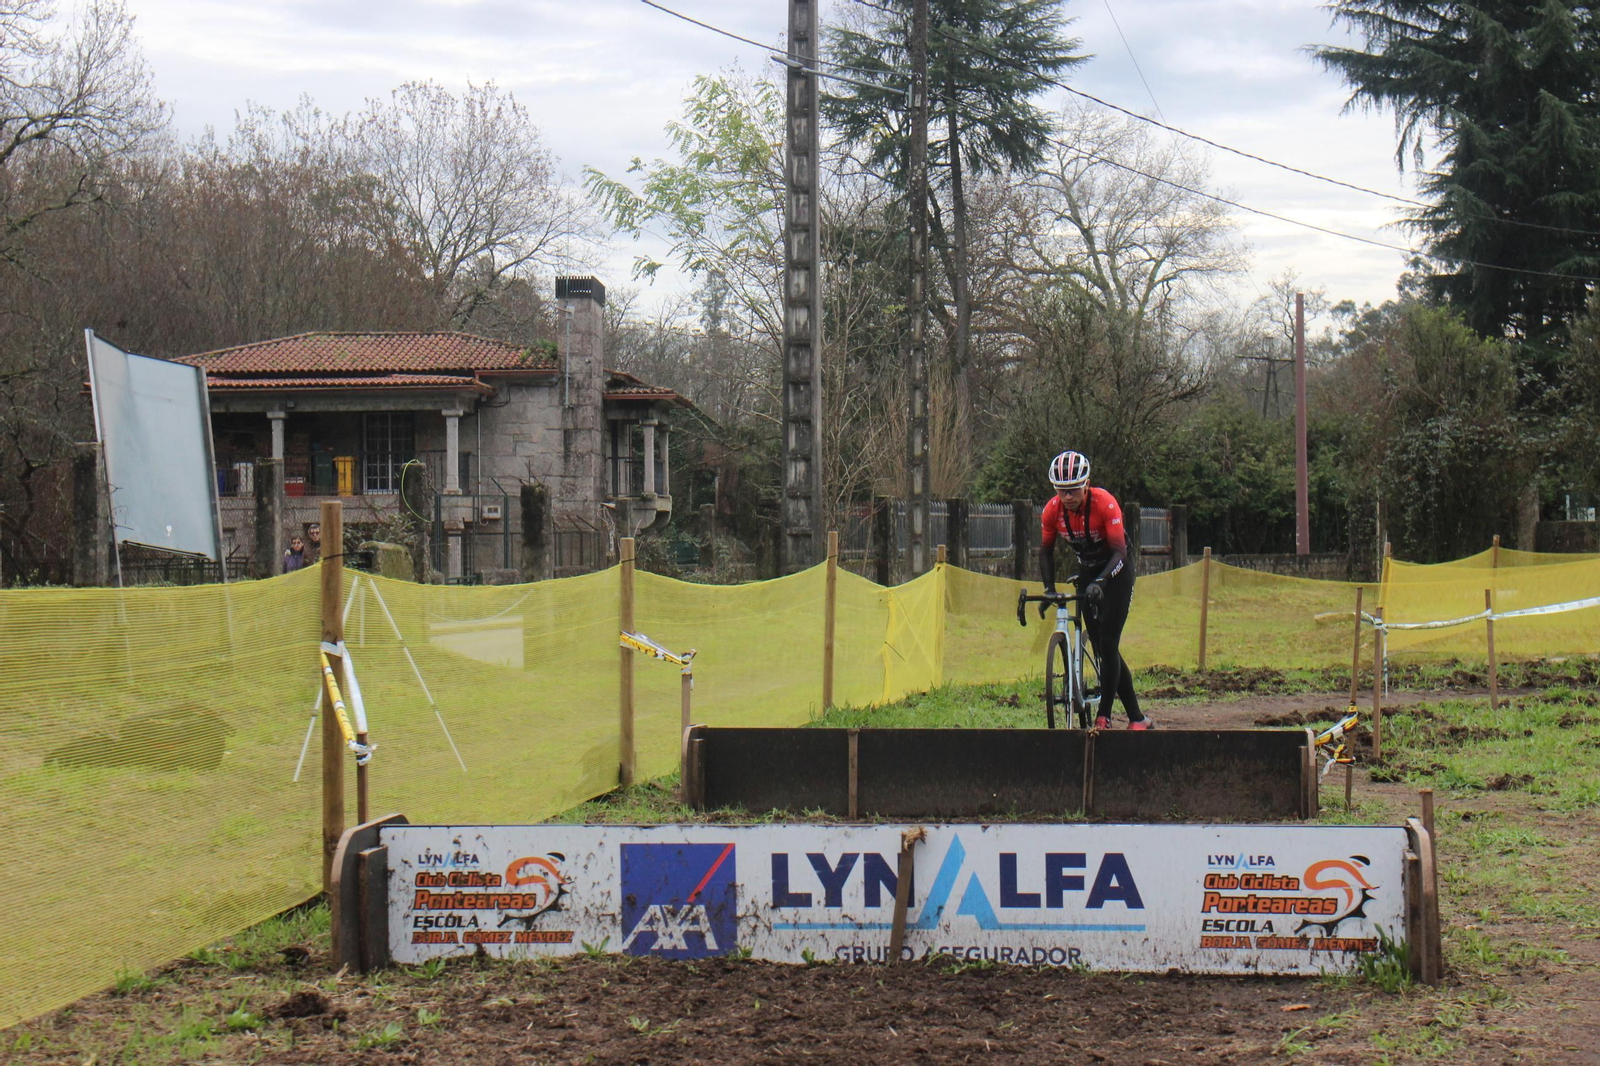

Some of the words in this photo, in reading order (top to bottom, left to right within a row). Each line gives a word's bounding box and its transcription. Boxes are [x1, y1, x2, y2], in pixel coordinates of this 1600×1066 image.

[415, 871, 447, 887] Club
[447, 871, 502, 887] Ciclista
[1204, 873, 1239, 890] Club
[1240, 873, 1300, 890] Ciclista
[413, 889, 536, 909] Ponteareas
[1201, 891, 1338, 915] Ponteareas
[413, 915, 479, 928] ESCOLA
[622, 904, 719, 950] AXA
[1202, 919, 1274, 933] ESCOLA
[1200, 935, 1252, 949] BORJA
